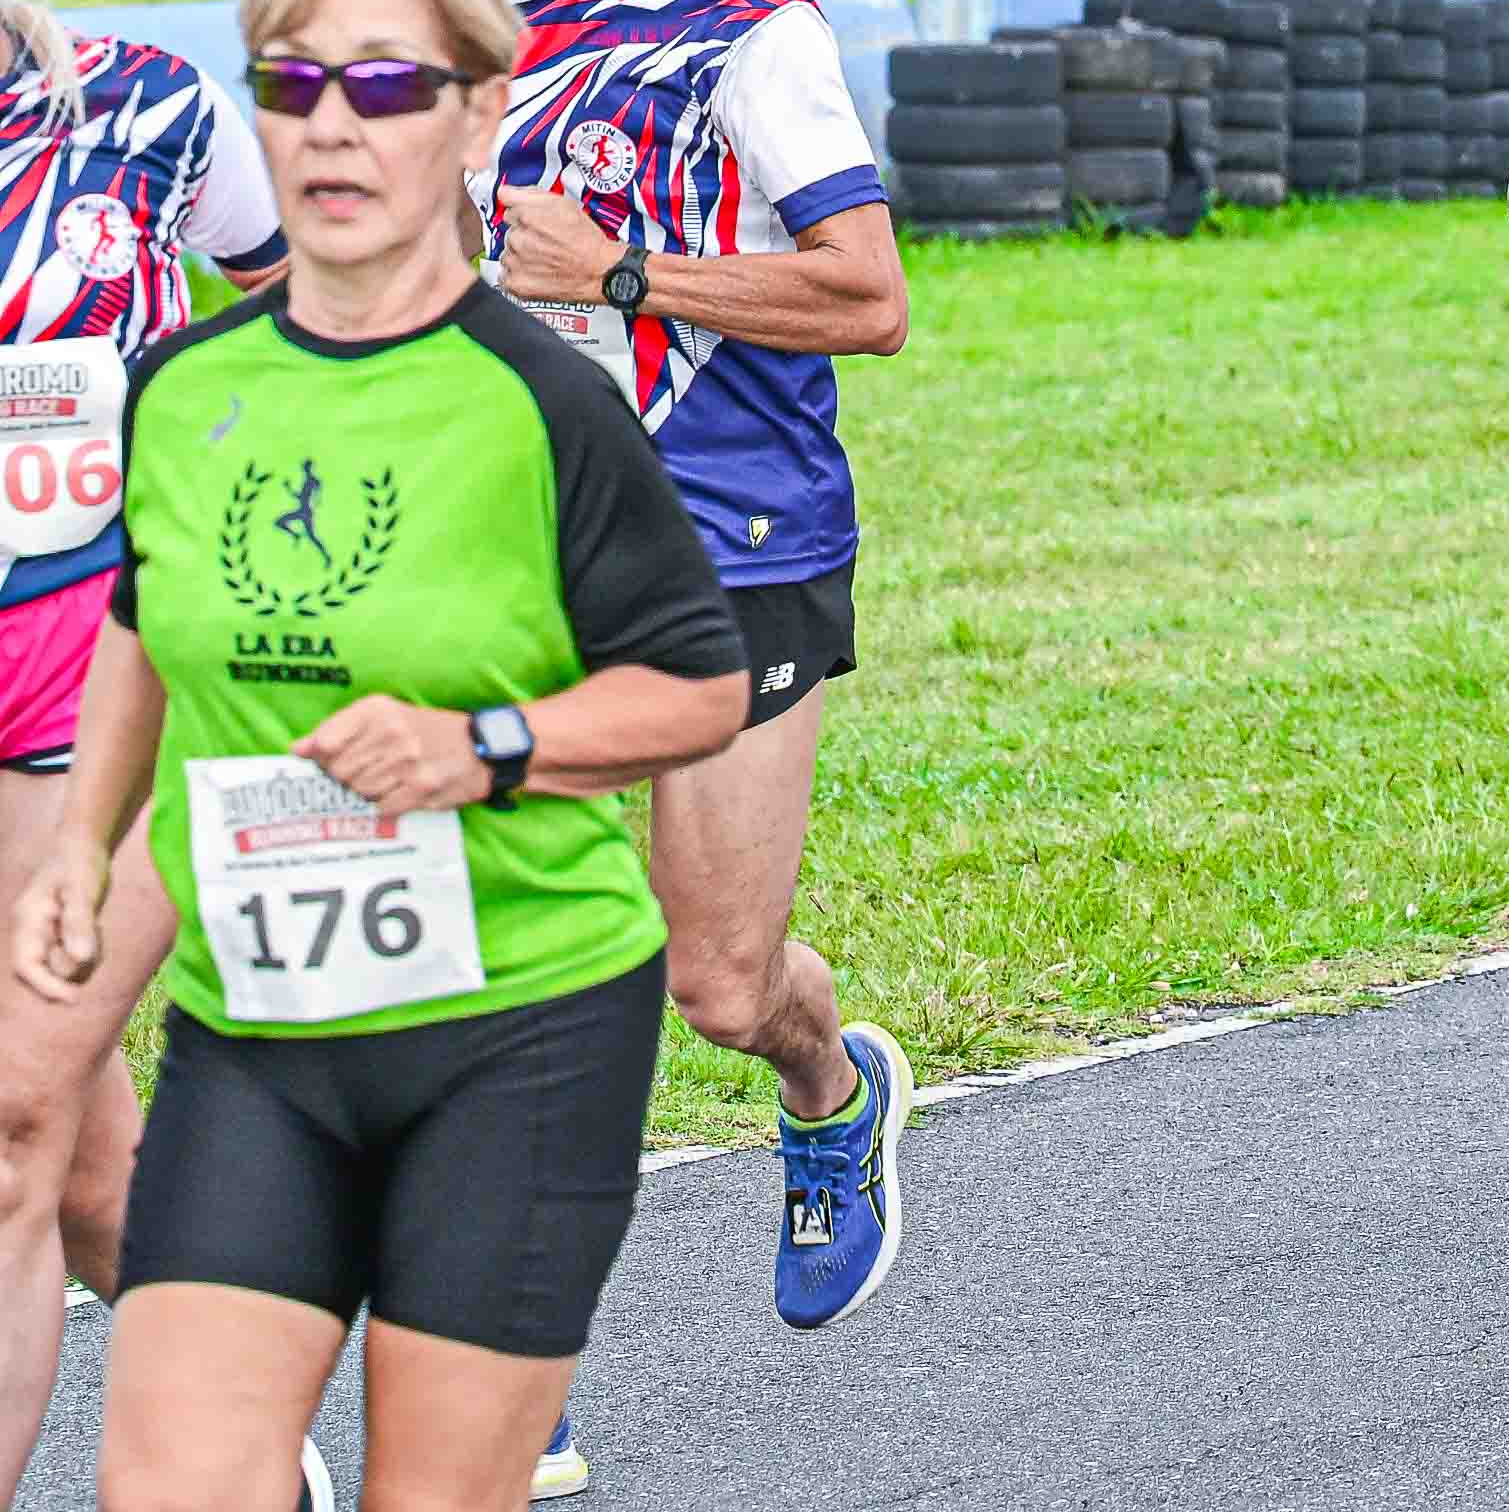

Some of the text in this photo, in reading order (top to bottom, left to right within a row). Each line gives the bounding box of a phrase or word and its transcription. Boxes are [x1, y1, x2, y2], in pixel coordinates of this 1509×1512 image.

[613, 156, 634, 188] TEAM
[234, 632, 272, 656] LA
[237, 879, 423, 971] 176
